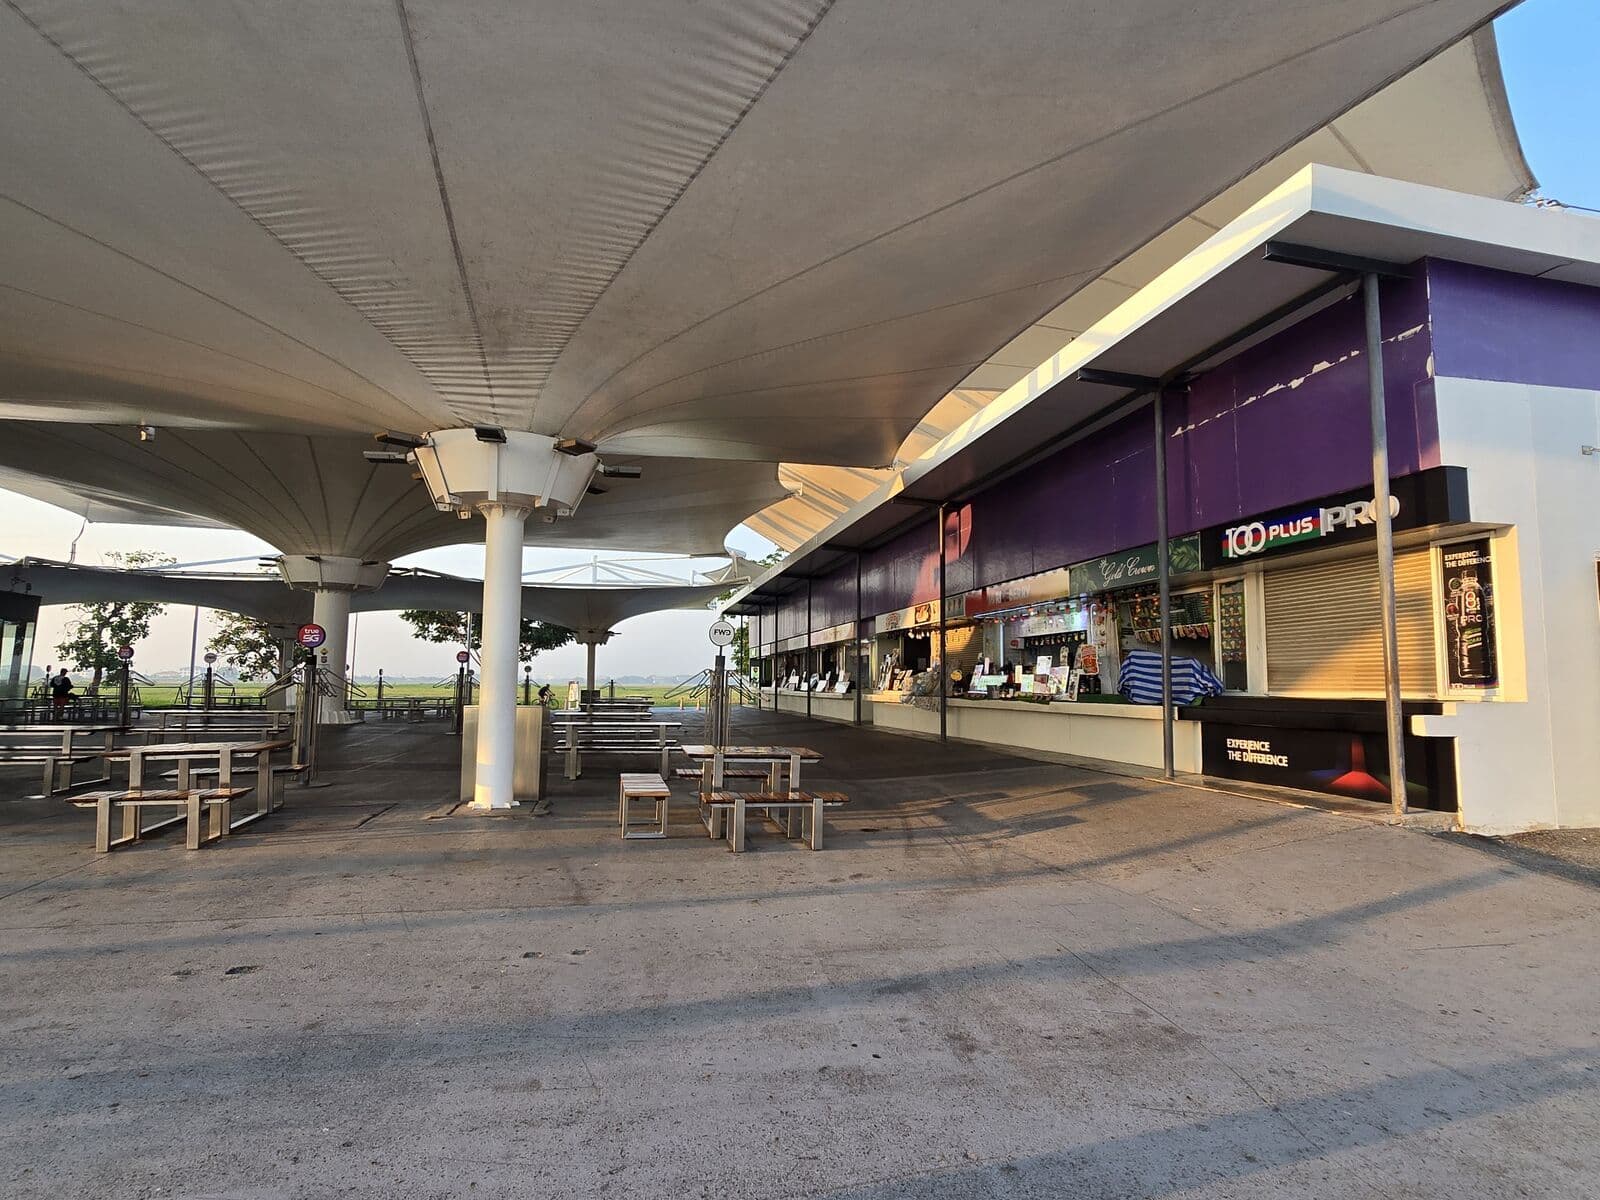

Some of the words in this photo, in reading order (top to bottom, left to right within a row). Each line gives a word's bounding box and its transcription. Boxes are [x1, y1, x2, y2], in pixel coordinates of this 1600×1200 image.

[1226, 522, 1267, 558] 100
[1269, 516, 1313, 541] PLUS
[1444, 550, 1480, 561] EXPERIENCE
[1445, 560, 1458, 568] THE
[714, 628, 731, 636] FWD
[302, 634, 320, 642] 5G
[1226, 738, 1271, 752] EXPERIENCE
[1227, 750, 1242, 761] THE
[1242, 751, 1289, 767] DIFFERENCE
